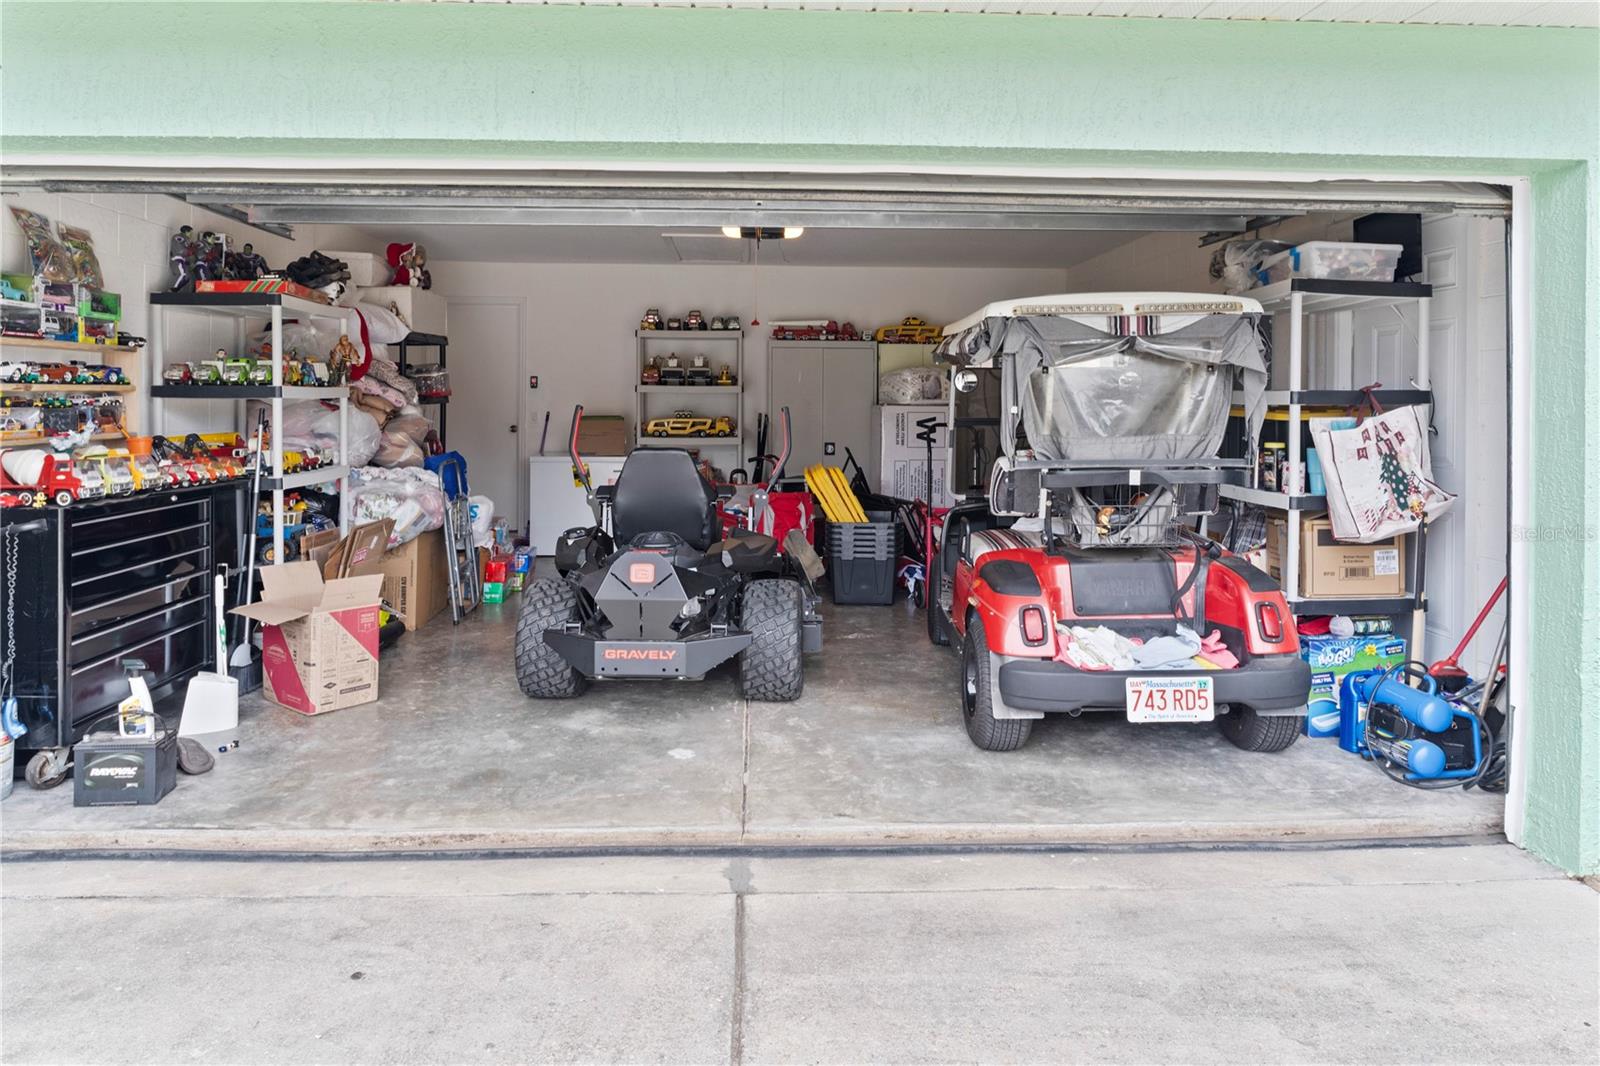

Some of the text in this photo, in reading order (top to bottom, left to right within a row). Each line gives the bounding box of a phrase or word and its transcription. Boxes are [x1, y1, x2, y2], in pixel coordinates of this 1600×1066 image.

[604, 649, 677, 660] GRAVELY
[1145, 680, 1193, 688] Massachusetts
[1131, 689, 1209, 712] 743 RD5
[89, 766, 139, 777] RAYOVAC
